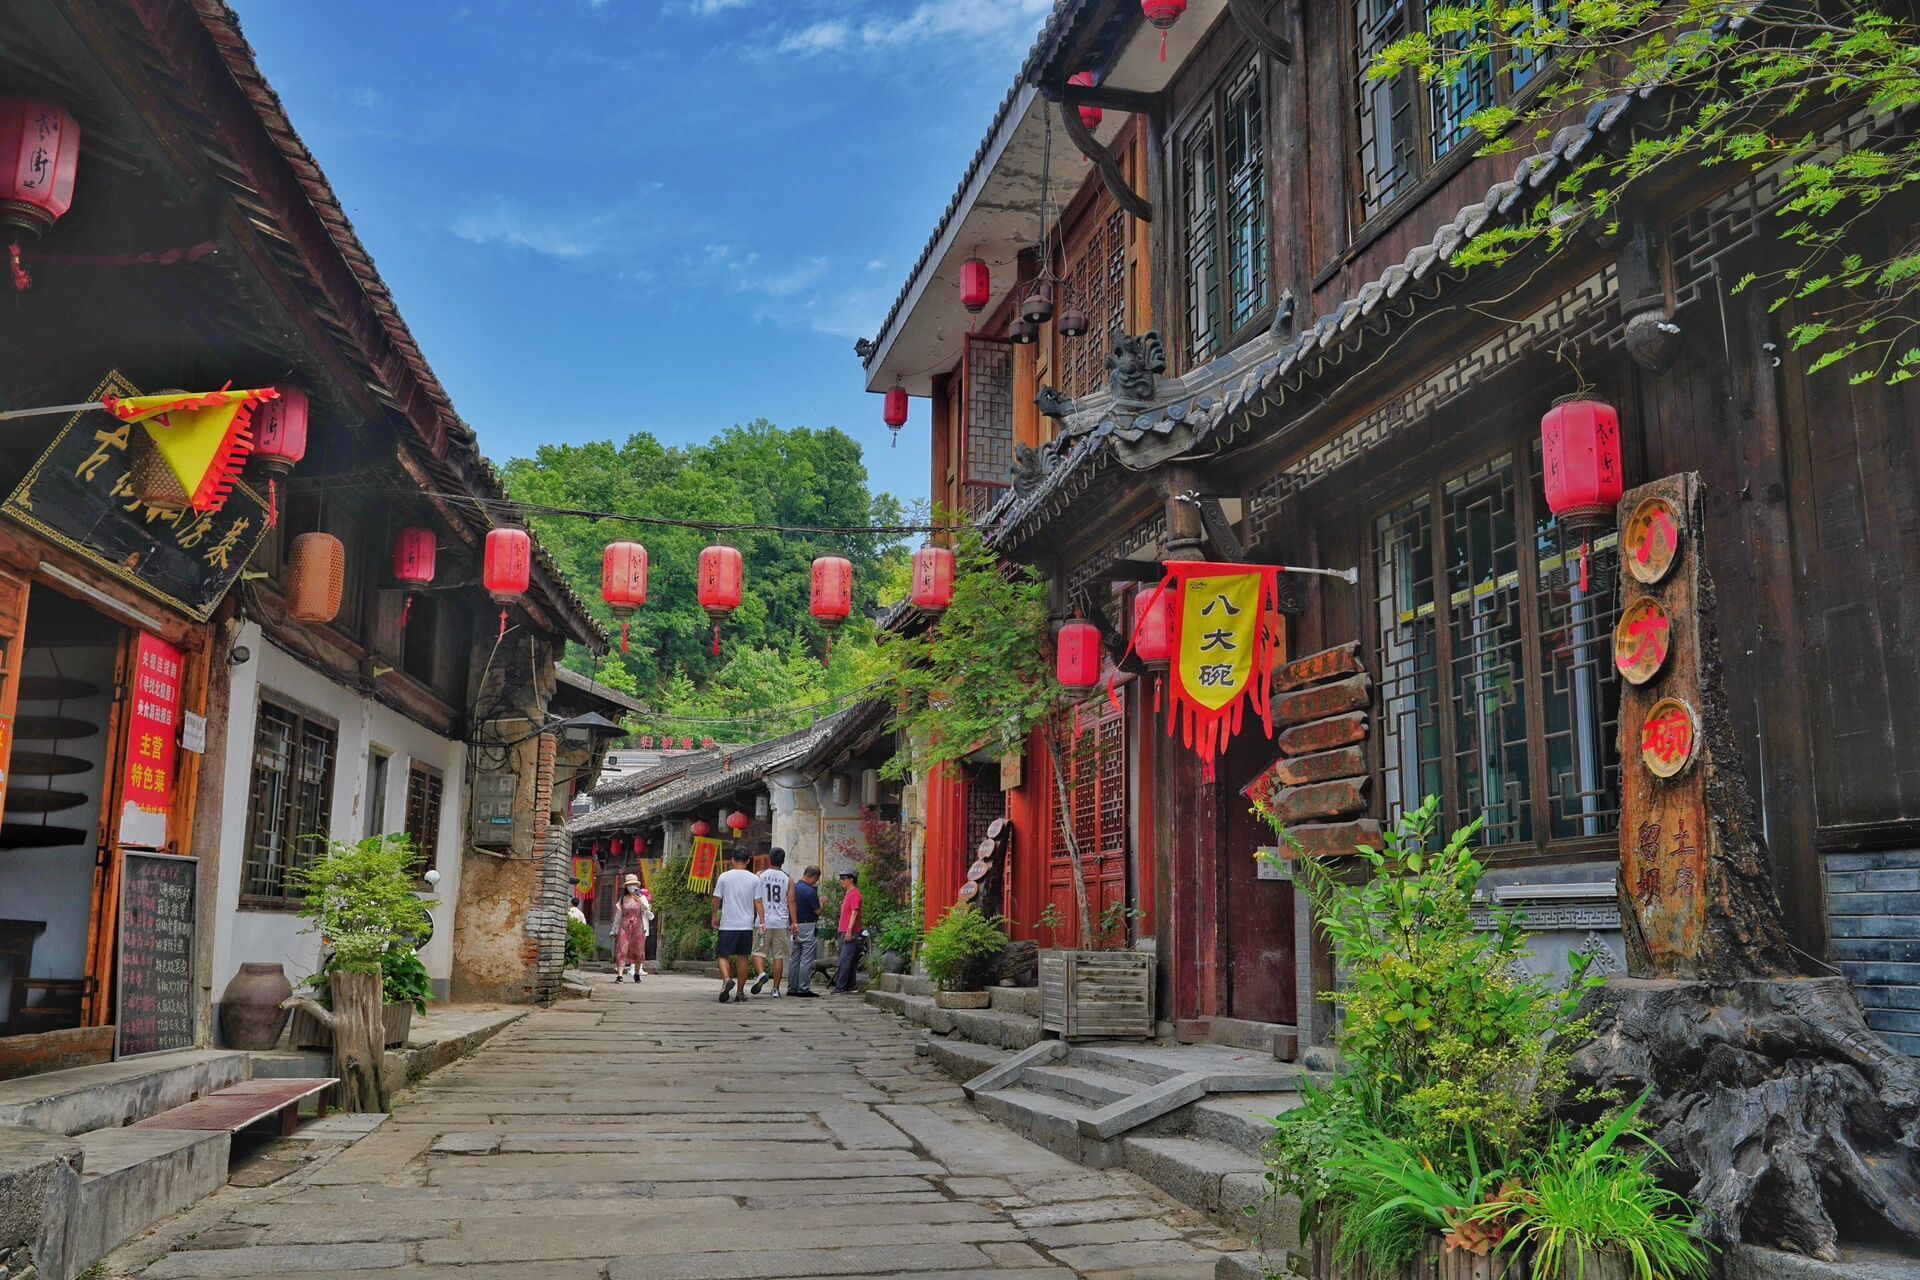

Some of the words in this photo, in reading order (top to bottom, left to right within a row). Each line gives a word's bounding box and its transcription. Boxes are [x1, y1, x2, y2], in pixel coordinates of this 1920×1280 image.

[1198, 594, 1240, 688] 八大碗
[1617, 508, 1691, 763] 八大碗
[140, 733, 163, 760] 主营
[131, 763, 166, 792] 特色菜
[766, 883, 781, 903] 18
